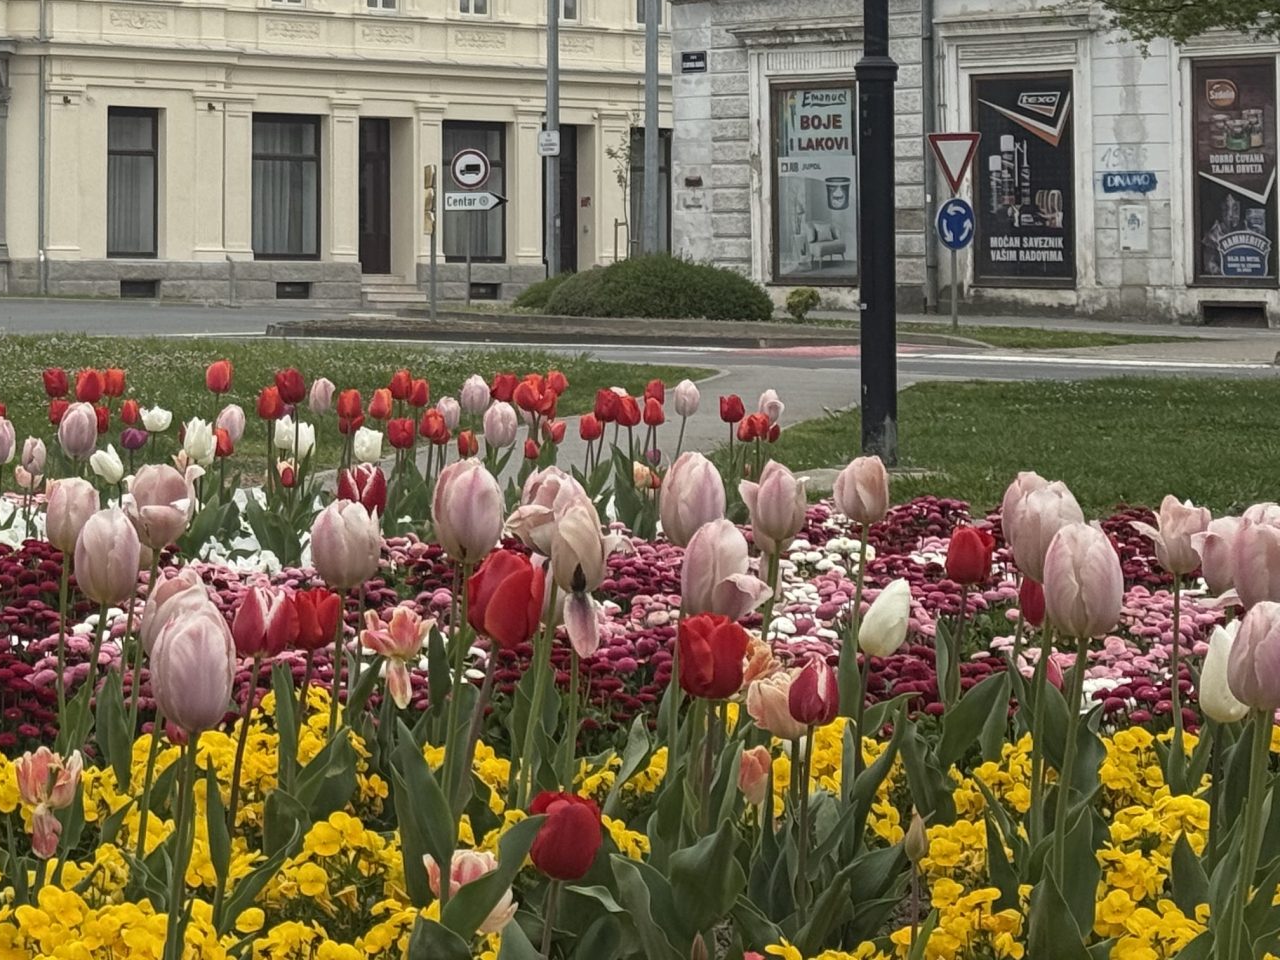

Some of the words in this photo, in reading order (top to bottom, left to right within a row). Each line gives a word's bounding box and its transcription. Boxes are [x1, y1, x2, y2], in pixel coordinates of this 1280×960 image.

[802, 91, 847, 107] Emanuel
[800, 114, 842, 130] BOJE
[790, 138, 794, 151] I
[798, 136, 849, 151] LAKOVI
[1210, 154, 1233, 163] DOBRO
[1212, 164, 1234, 173] TAJNA
[1236, 164, 1263, 173] DRVETA
[447, 196, 476, 207] Centar
[1022, 237, 1063, 248] SAVEZNIK
[1222, 235, 1267, 250] HAMMERITE
[990, 249, 1017, 261] VAŠIM
[1019, 250, 1063, 261] RADOVIMA
